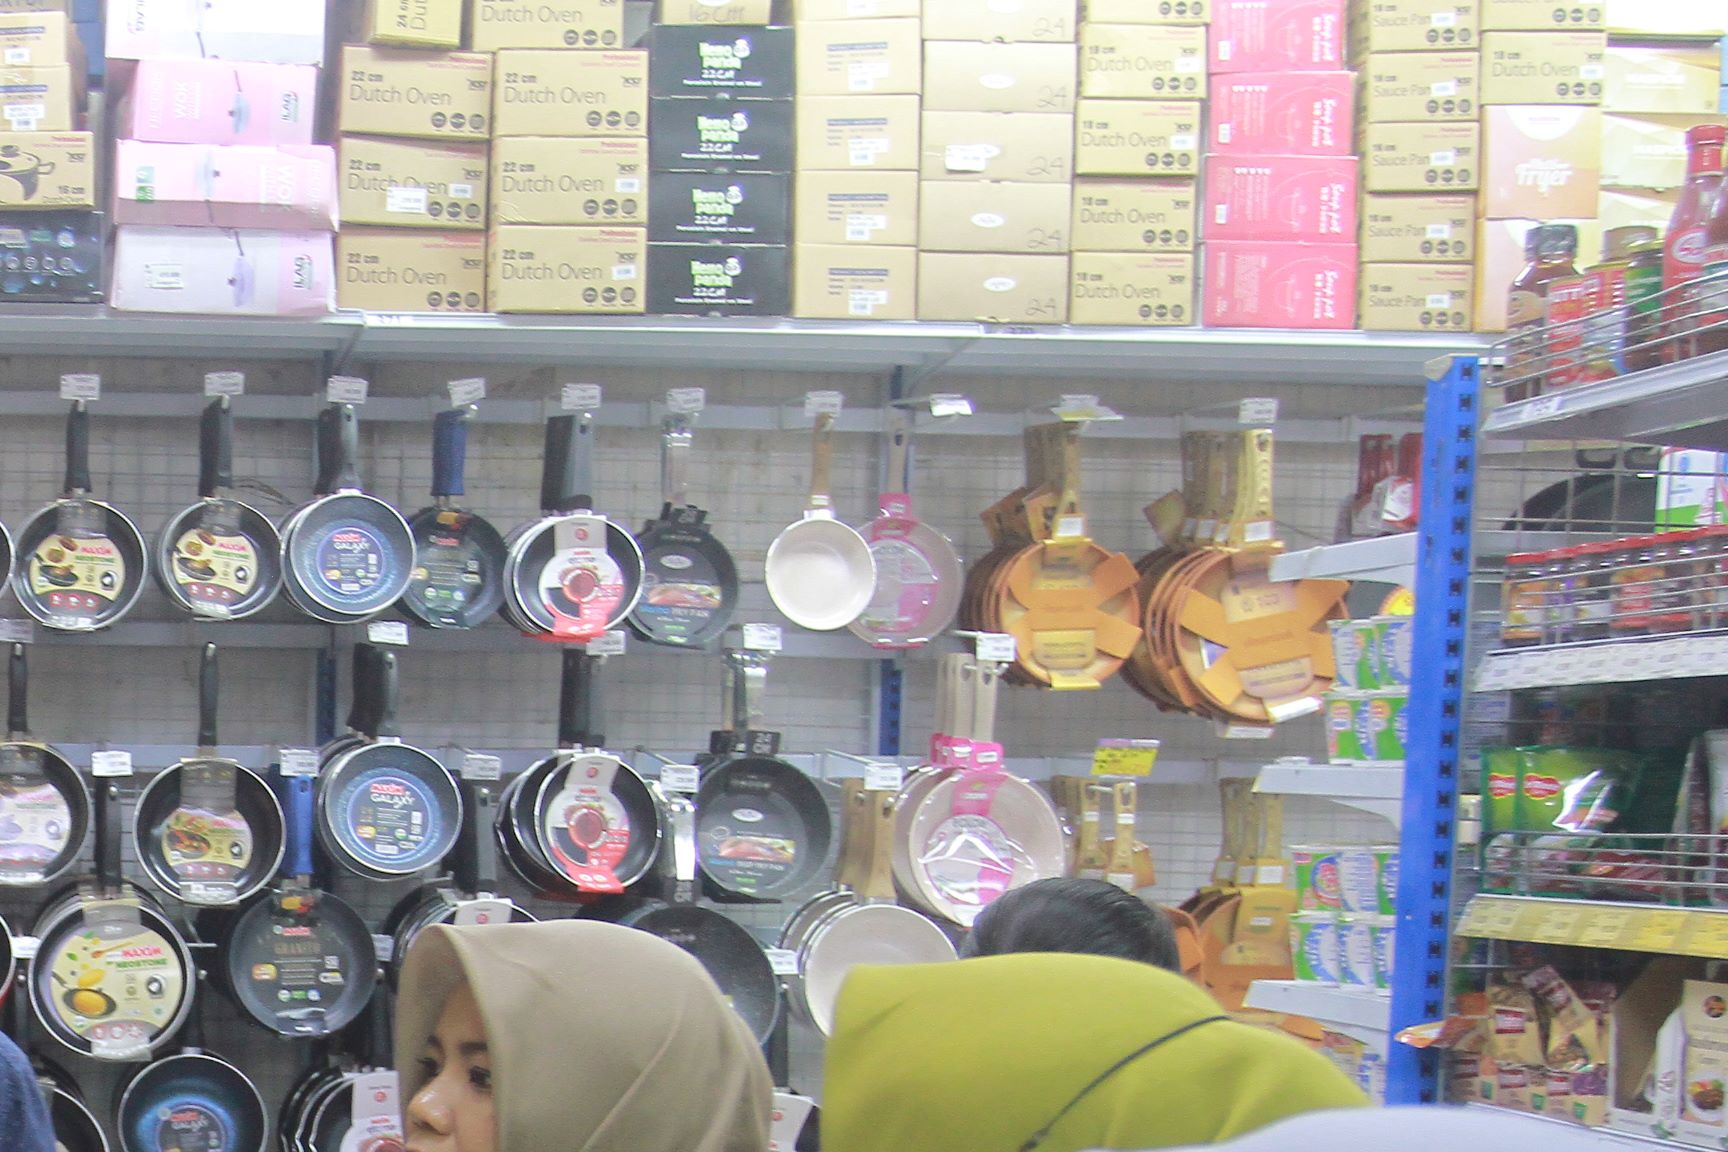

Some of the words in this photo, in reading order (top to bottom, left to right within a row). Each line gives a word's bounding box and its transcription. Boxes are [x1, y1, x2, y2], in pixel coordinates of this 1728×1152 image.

[480, 4, 533, 22] Dutch
[537, 5, 582, 23] Oven
[367, 73, 383, 82] cm
[521, 74, 537, 83] cm
[349, 84, 402, 103] Dutch
[406, 86, 452, 105] Oven
[503, 86, 555, 104] Dutch
[560, 86, 606, 104] Oven
[366, 162, 381, 171] cm
[519, 163, 535, 172] cm
[347, 172, 399, 191] Dutch
[502, 174, 554, 192] Dutch
[558, 175, 604, 192] Oven
[364, 255, 379, 264] cm
[518, 251, 534, 260] cm
[346, 266, 397, 284] Dutch
[402, 267, 447, 285] Oven
[501, 262, 553, 280] Dutch
[558, 262, 603, 280] Oven
